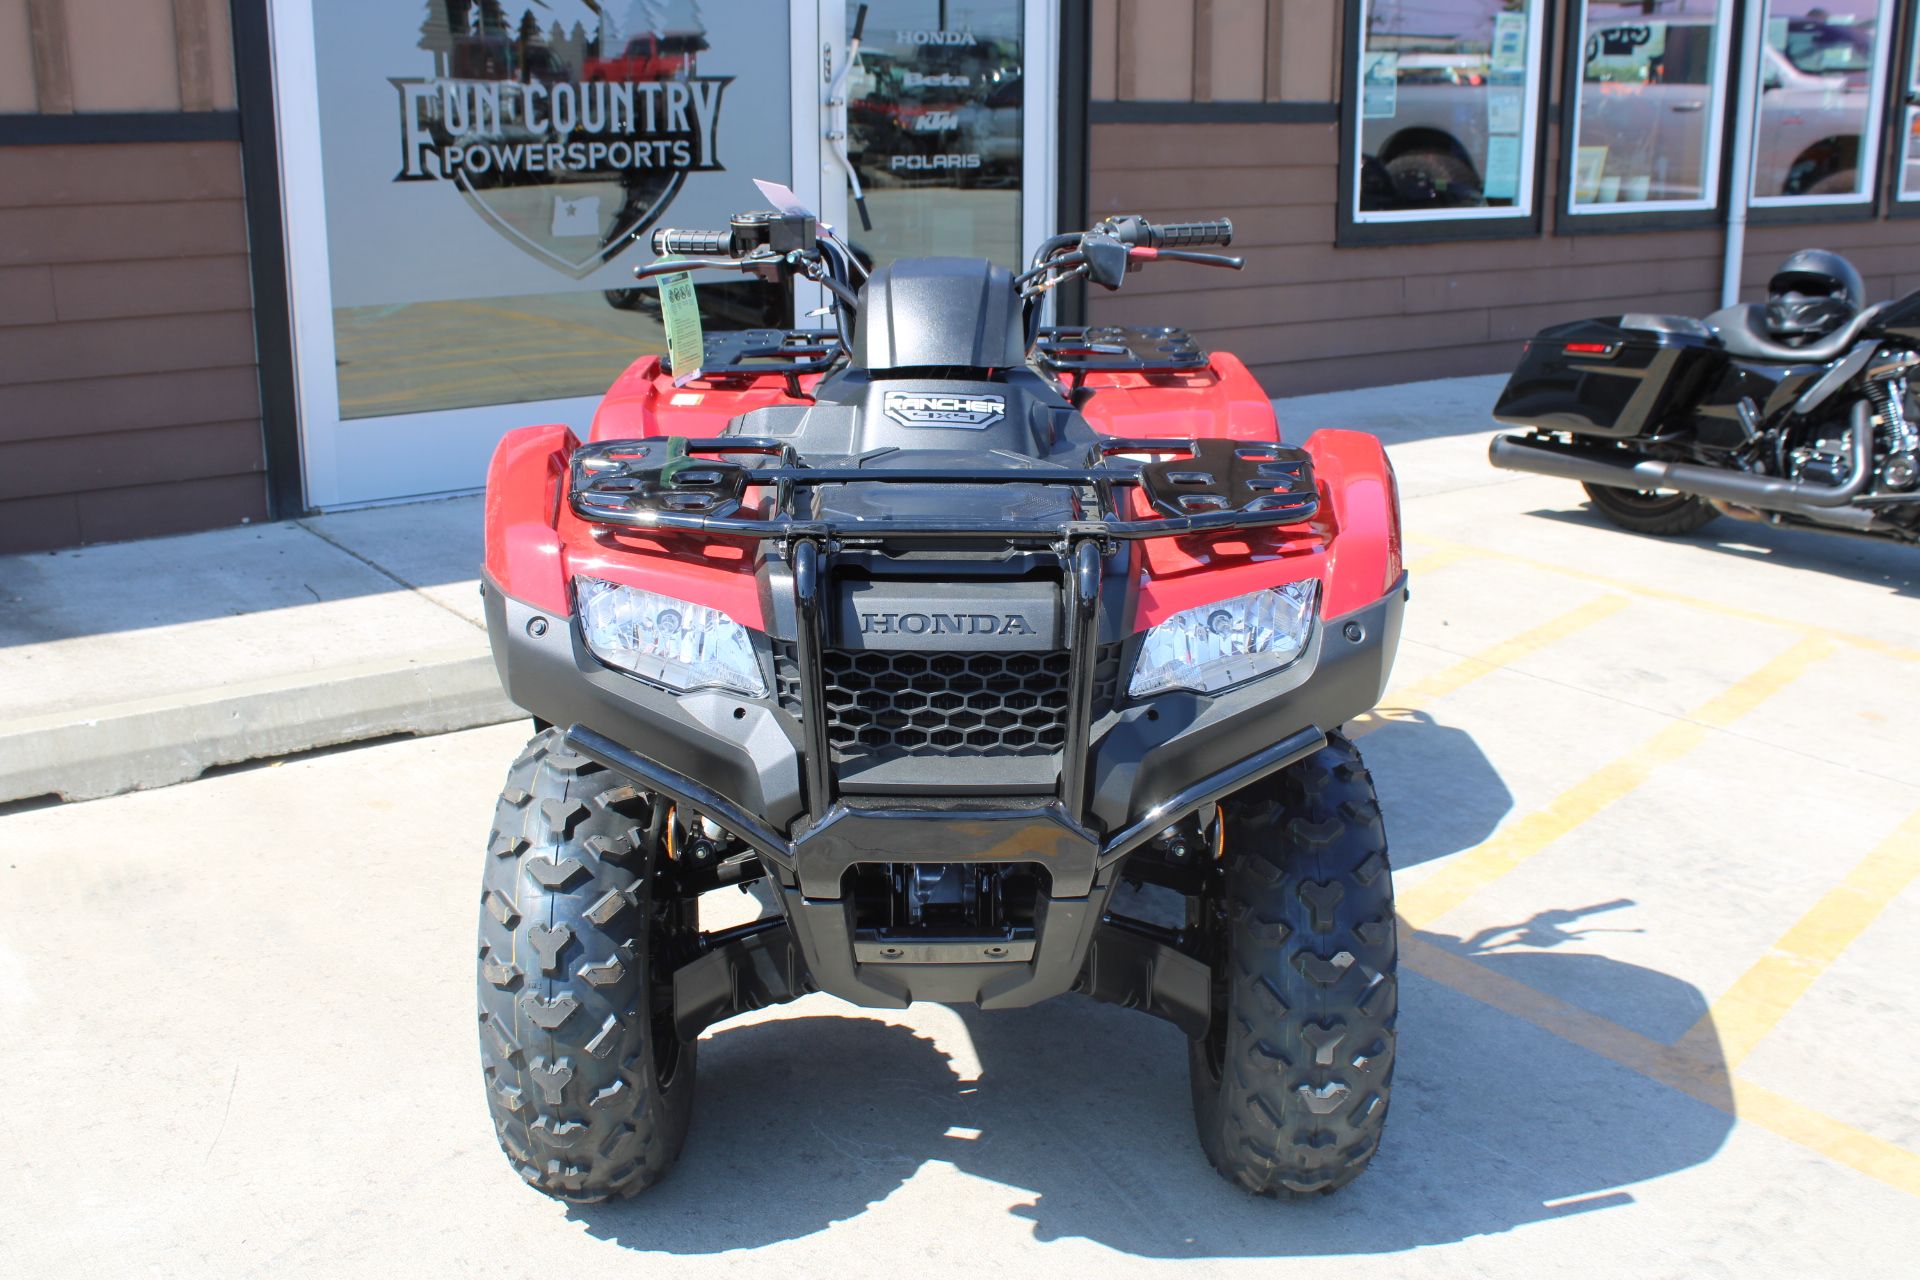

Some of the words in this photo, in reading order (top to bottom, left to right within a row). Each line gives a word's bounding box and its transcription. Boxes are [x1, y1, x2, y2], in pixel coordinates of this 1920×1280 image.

[896, 31, 977, 46] HONDA
[903, 72, 970, 87] Beta
[402, 80, 501, 175] FUN
[522, 80, 722, 166] COUNTRY
[915, 111, 958, 130] KTM
[444, 140, 691, 174] POWERSPORTS
[891, 154, 981, 169] POLARIS
[884, 397, 1005, 415] RANCHER
[861, 613, 1037, 636] HONDA
